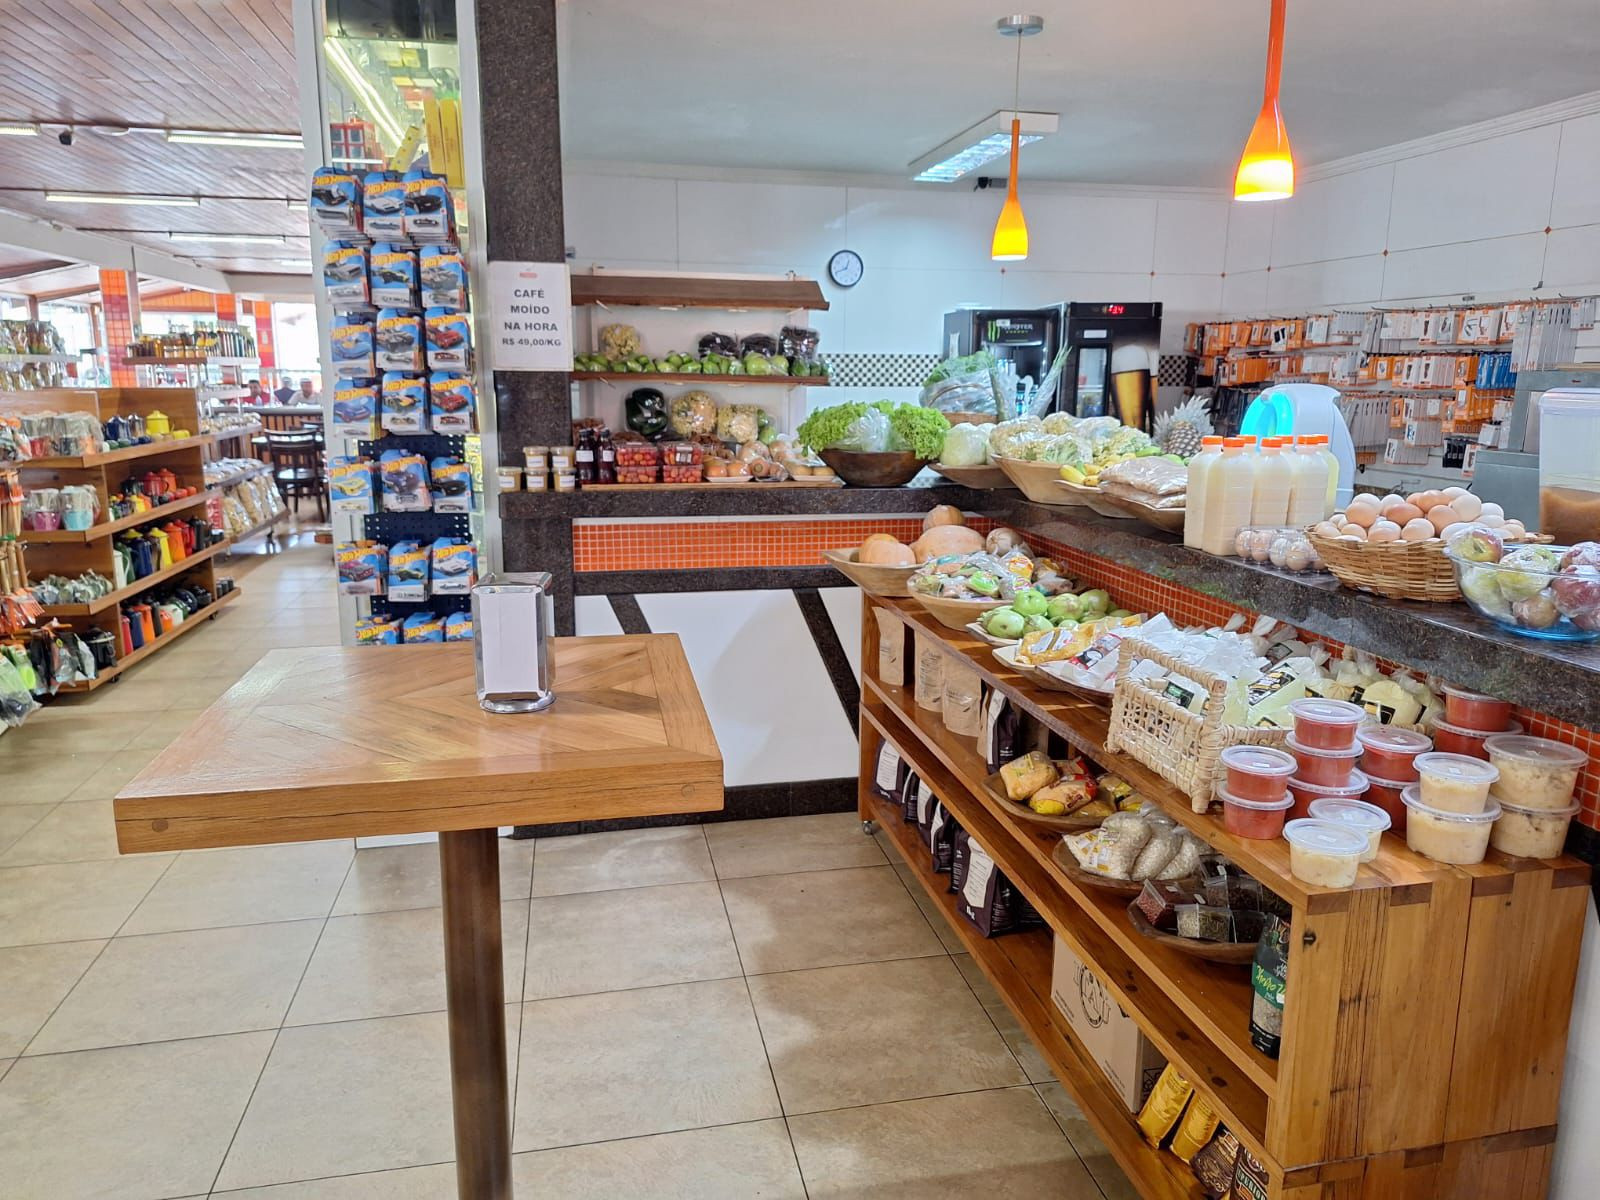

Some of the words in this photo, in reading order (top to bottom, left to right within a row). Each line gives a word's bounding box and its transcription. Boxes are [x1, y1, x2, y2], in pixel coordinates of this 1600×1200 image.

[514, 288, 545, 298] CAFÉ
[510, 305, 550, 315] MOÍDO
[504, 322, 521, 331] NA
[525, 322, 558, 331] HORA
